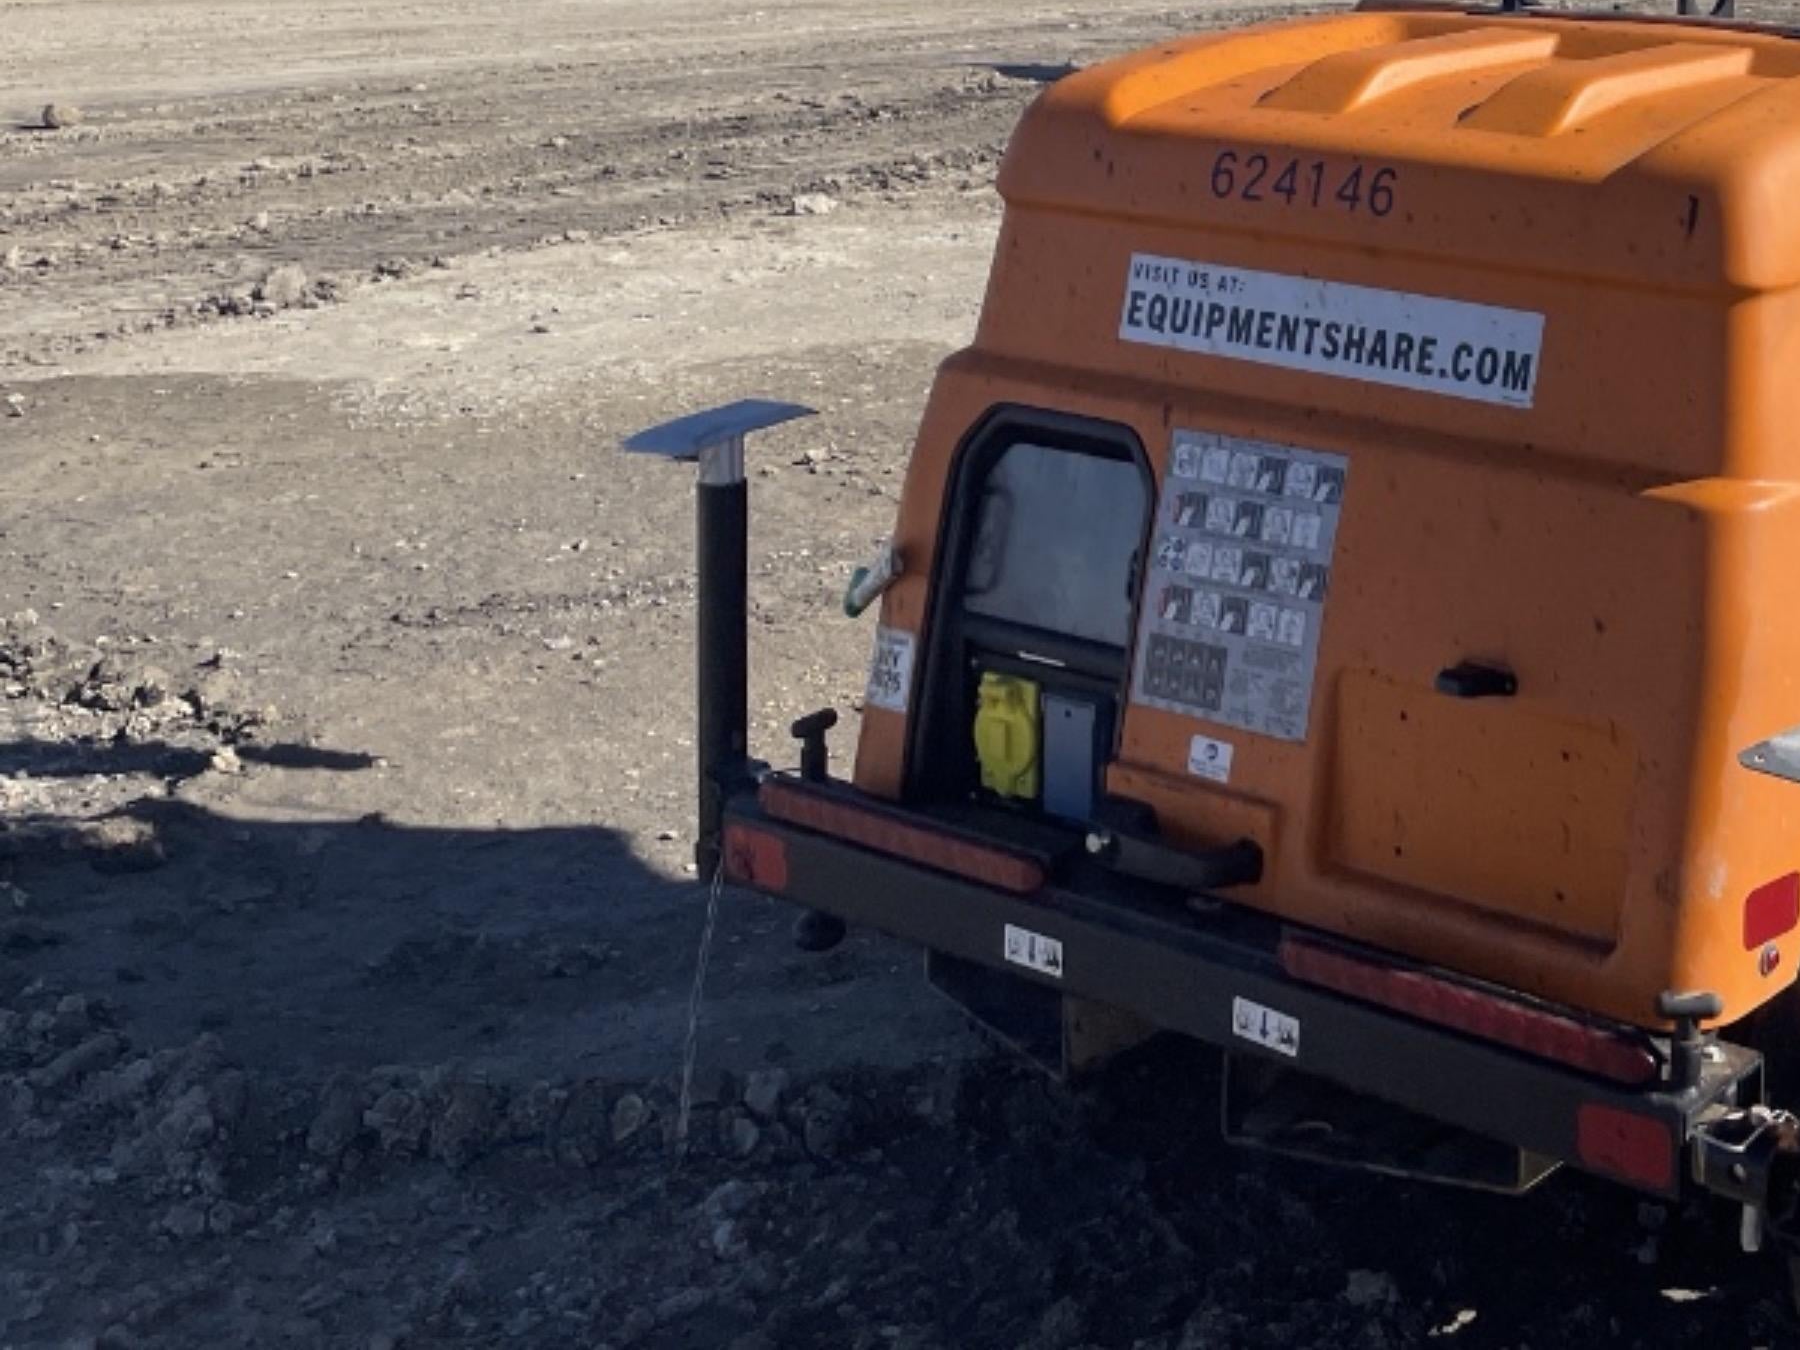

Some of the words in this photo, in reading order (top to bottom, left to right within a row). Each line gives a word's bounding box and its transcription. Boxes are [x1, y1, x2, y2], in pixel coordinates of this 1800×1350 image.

[1211, 151, 1396, 216] 624146
[1133, 262, 1180, 288] VISIT
[1189, 270, 1210, 290] US
[1218, 274, 1246, 294] AT:
[1127, 290, 1534, 393] EQUIPMENTSHARE.COM
